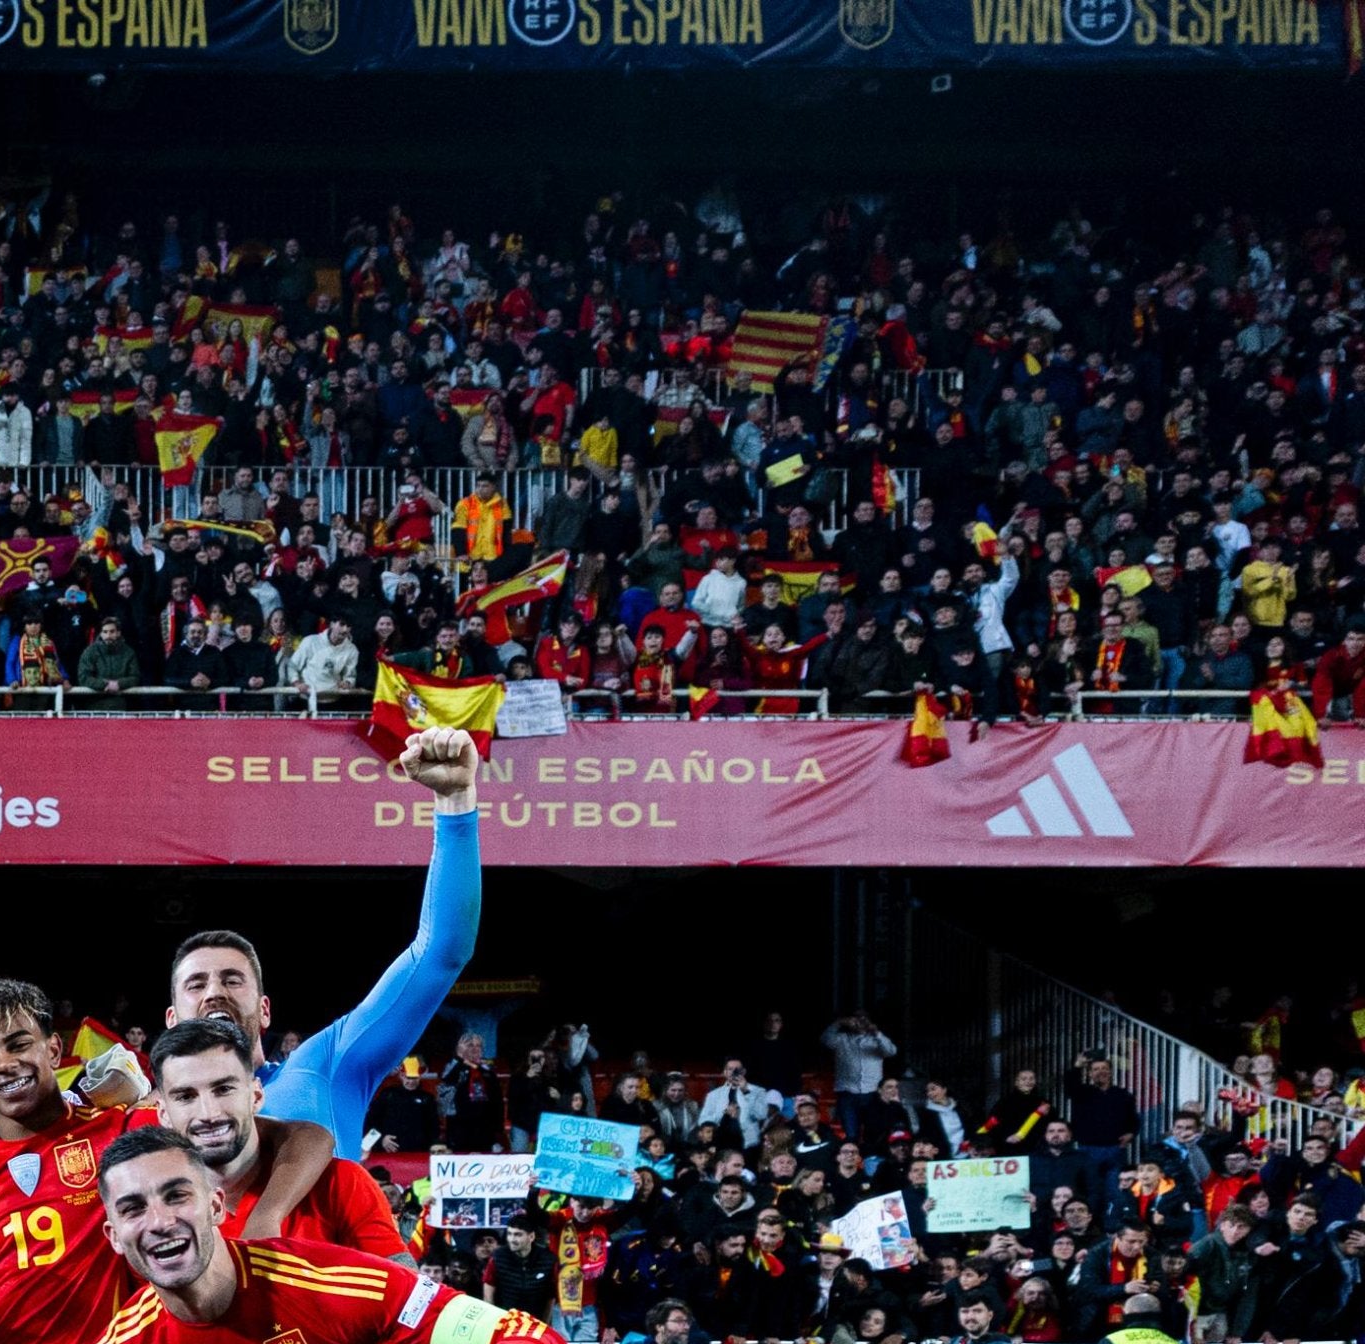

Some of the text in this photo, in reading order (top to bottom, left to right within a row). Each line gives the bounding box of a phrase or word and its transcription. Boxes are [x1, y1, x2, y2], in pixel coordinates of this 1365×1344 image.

[206, 750, 825, 784] SELECCN ESPAÑOLA
[1285, 759, 1365, 785] SE
[374, 793, 676, 827] DE FÚTBOL
[436, 1162, 484, 1179] NICO
[933, 1159, 1020, 1181] ASENCIO
[2, 1205, 66, 1270] 19
